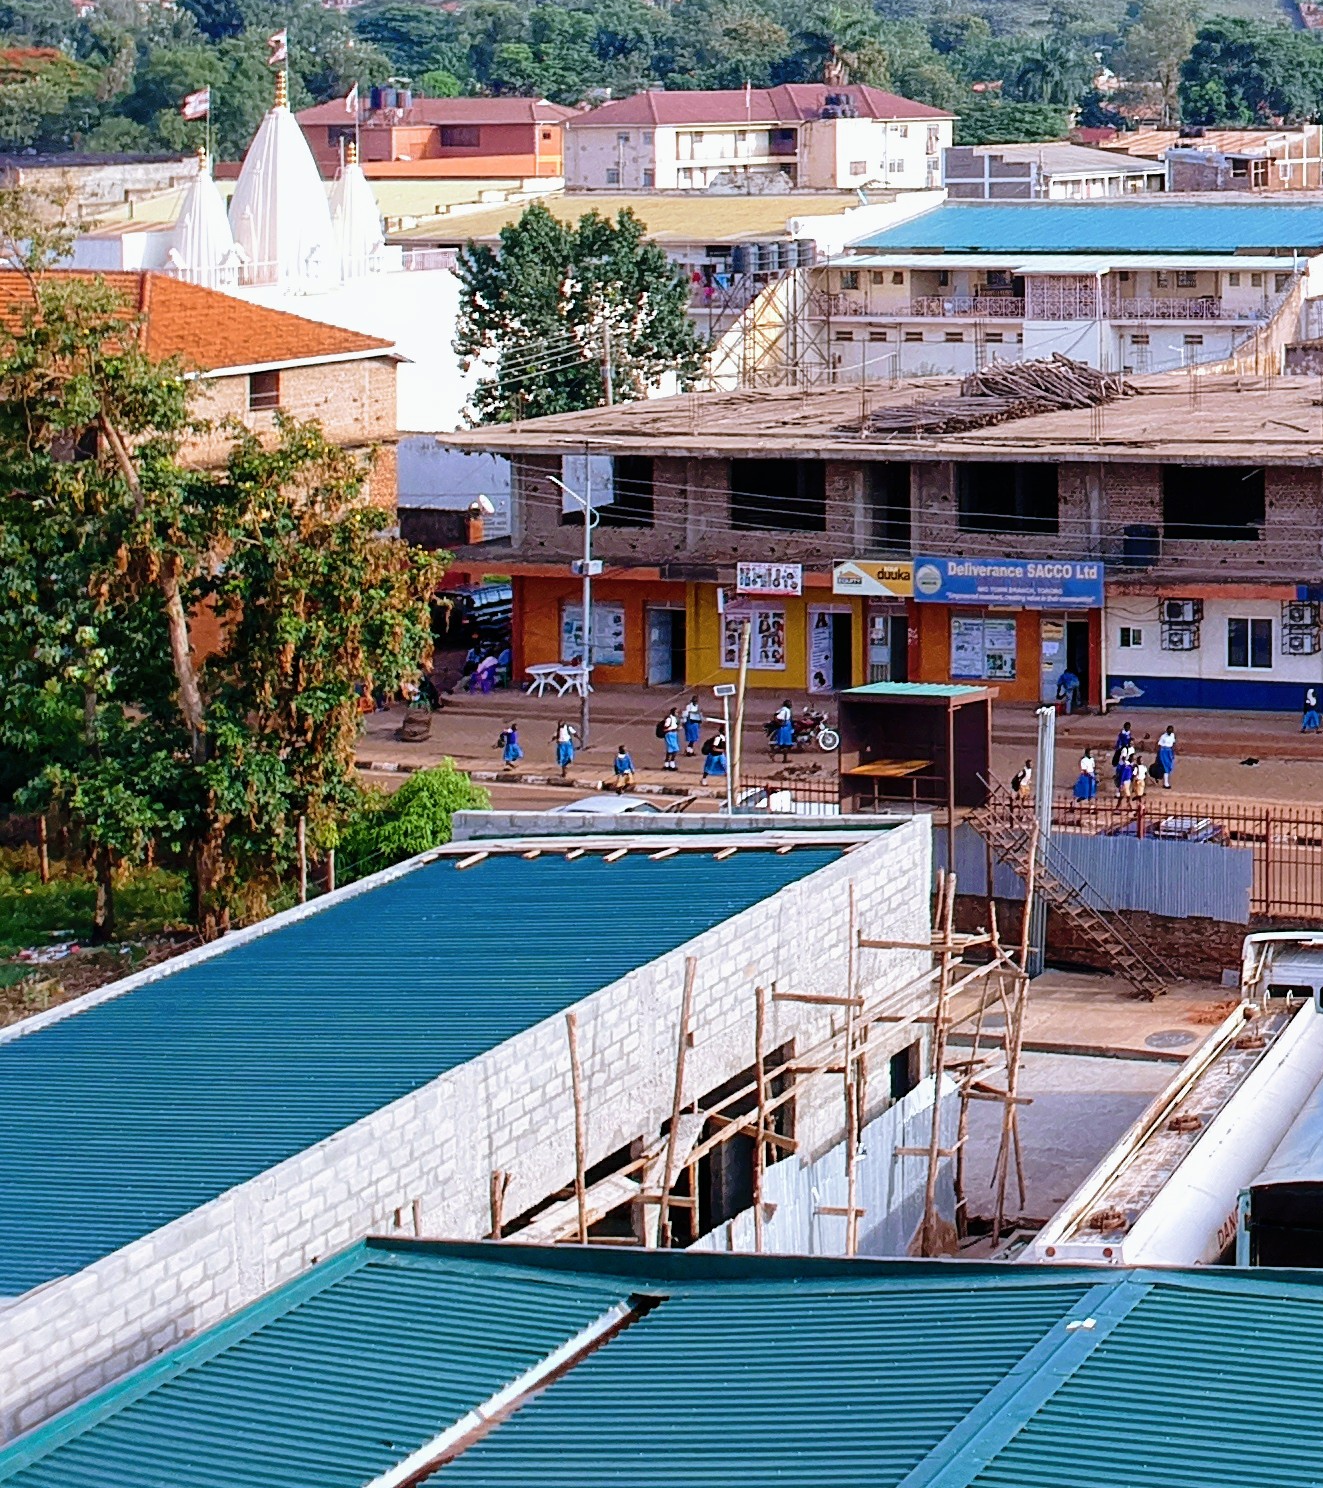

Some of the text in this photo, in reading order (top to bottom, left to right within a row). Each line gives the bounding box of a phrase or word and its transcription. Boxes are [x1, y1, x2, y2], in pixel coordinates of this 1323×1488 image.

[877, 568, 911, 581] duuka
[948, 562, 1098, 580] Deliverance SACCO Ltd
